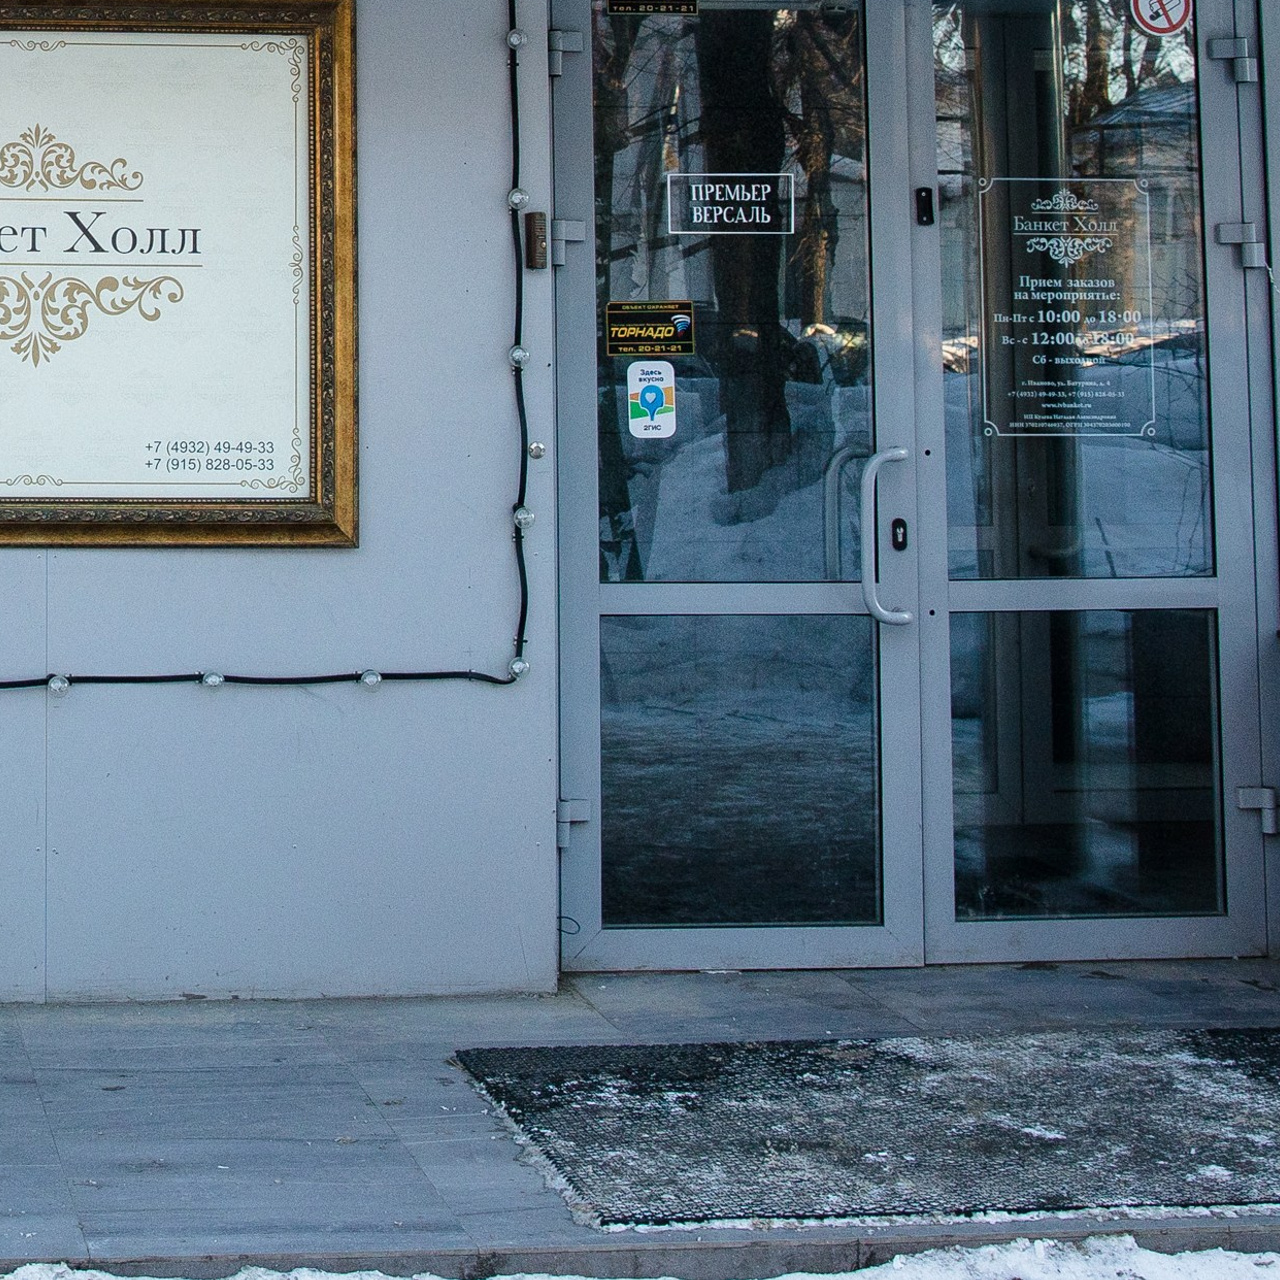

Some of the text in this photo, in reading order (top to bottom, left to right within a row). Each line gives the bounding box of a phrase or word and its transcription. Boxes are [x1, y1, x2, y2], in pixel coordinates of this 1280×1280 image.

[691, 184, 771, 201] ПРЕМЬЕР
[692, 206, 771, 223] ВЕРСАЛЬ
[1013, 216, 1118, 231] Банкет Холл
[64, 212, 202, 254] Холл
[1019, 275, 1115, 290] Прием заказов
[1014, 291, 1120, 303] на мероприятие:
[993, 314, 1027, 323] Пн-Пт
[1038, 310, 1080, 323] 10:00
[1083, 316, 1096, 324] до
[1099, 310, 1141, 323] 18:00
[610, 327, 675, 339] ТОРНАДО
[1002, 336, 1015, 345] Вс
[1032, 332, 1074, 345] 12:00
[1091, 332, 1134, 345] 18:00
[1032, 355, 1047, 365] Сб
[1054, 356, 1106, 366] выходной
[638, 376, 665, 384] вкусно
[1016, 390, 1037, 398] (4932)
[145, 440, 275, 455] +7 (4932) 49-49-33
[145, 458, 275, 472] +7 (915) 828-05-33
